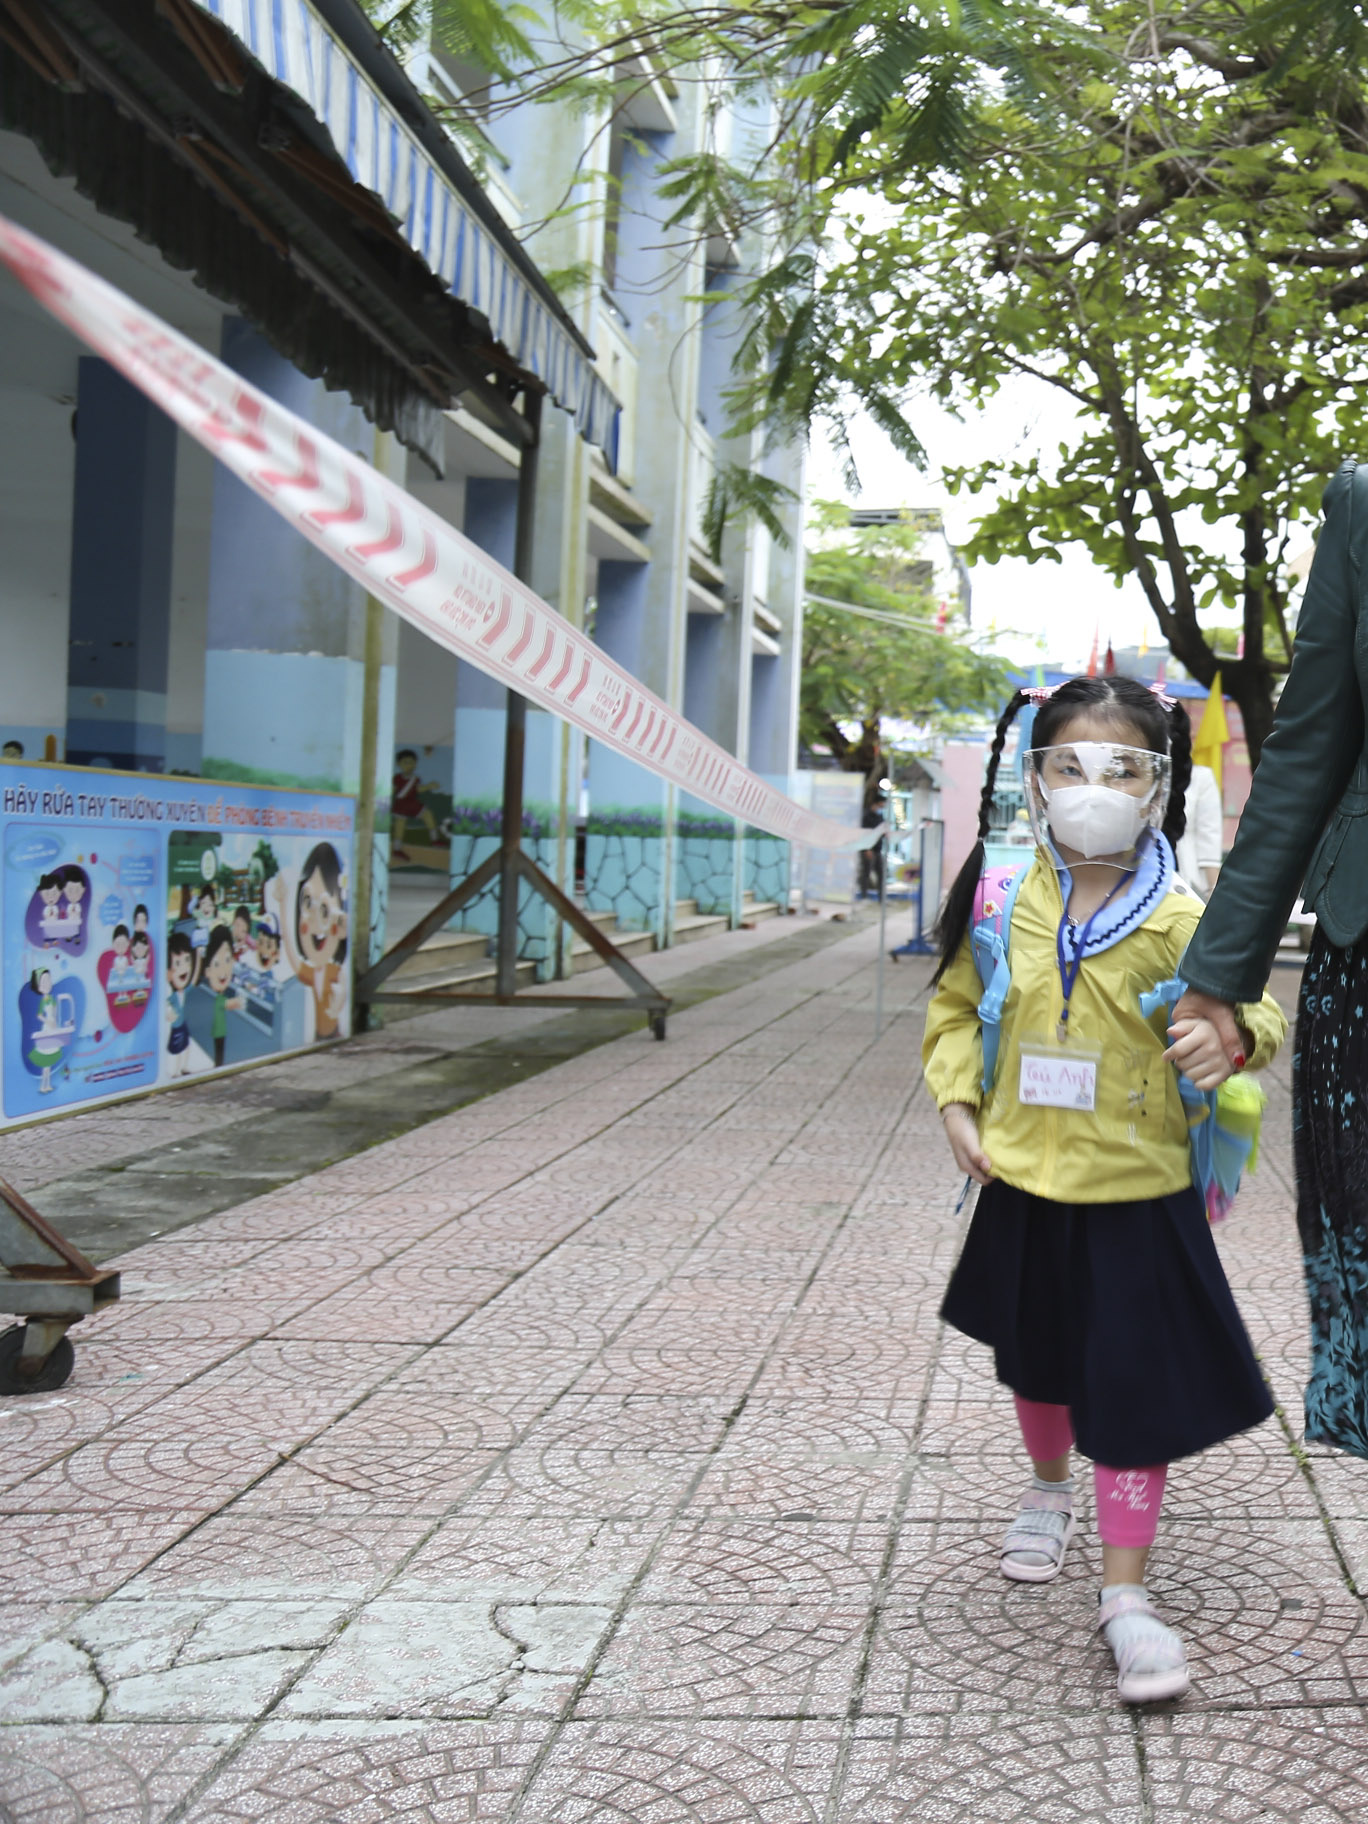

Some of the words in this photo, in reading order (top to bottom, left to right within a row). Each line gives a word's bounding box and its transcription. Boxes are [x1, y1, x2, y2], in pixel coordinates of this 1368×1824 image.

[4, 782, 38, 815] HÃY
[42, 783, 75, 817] RỬA
[78, 794, 107, 819] TAY
